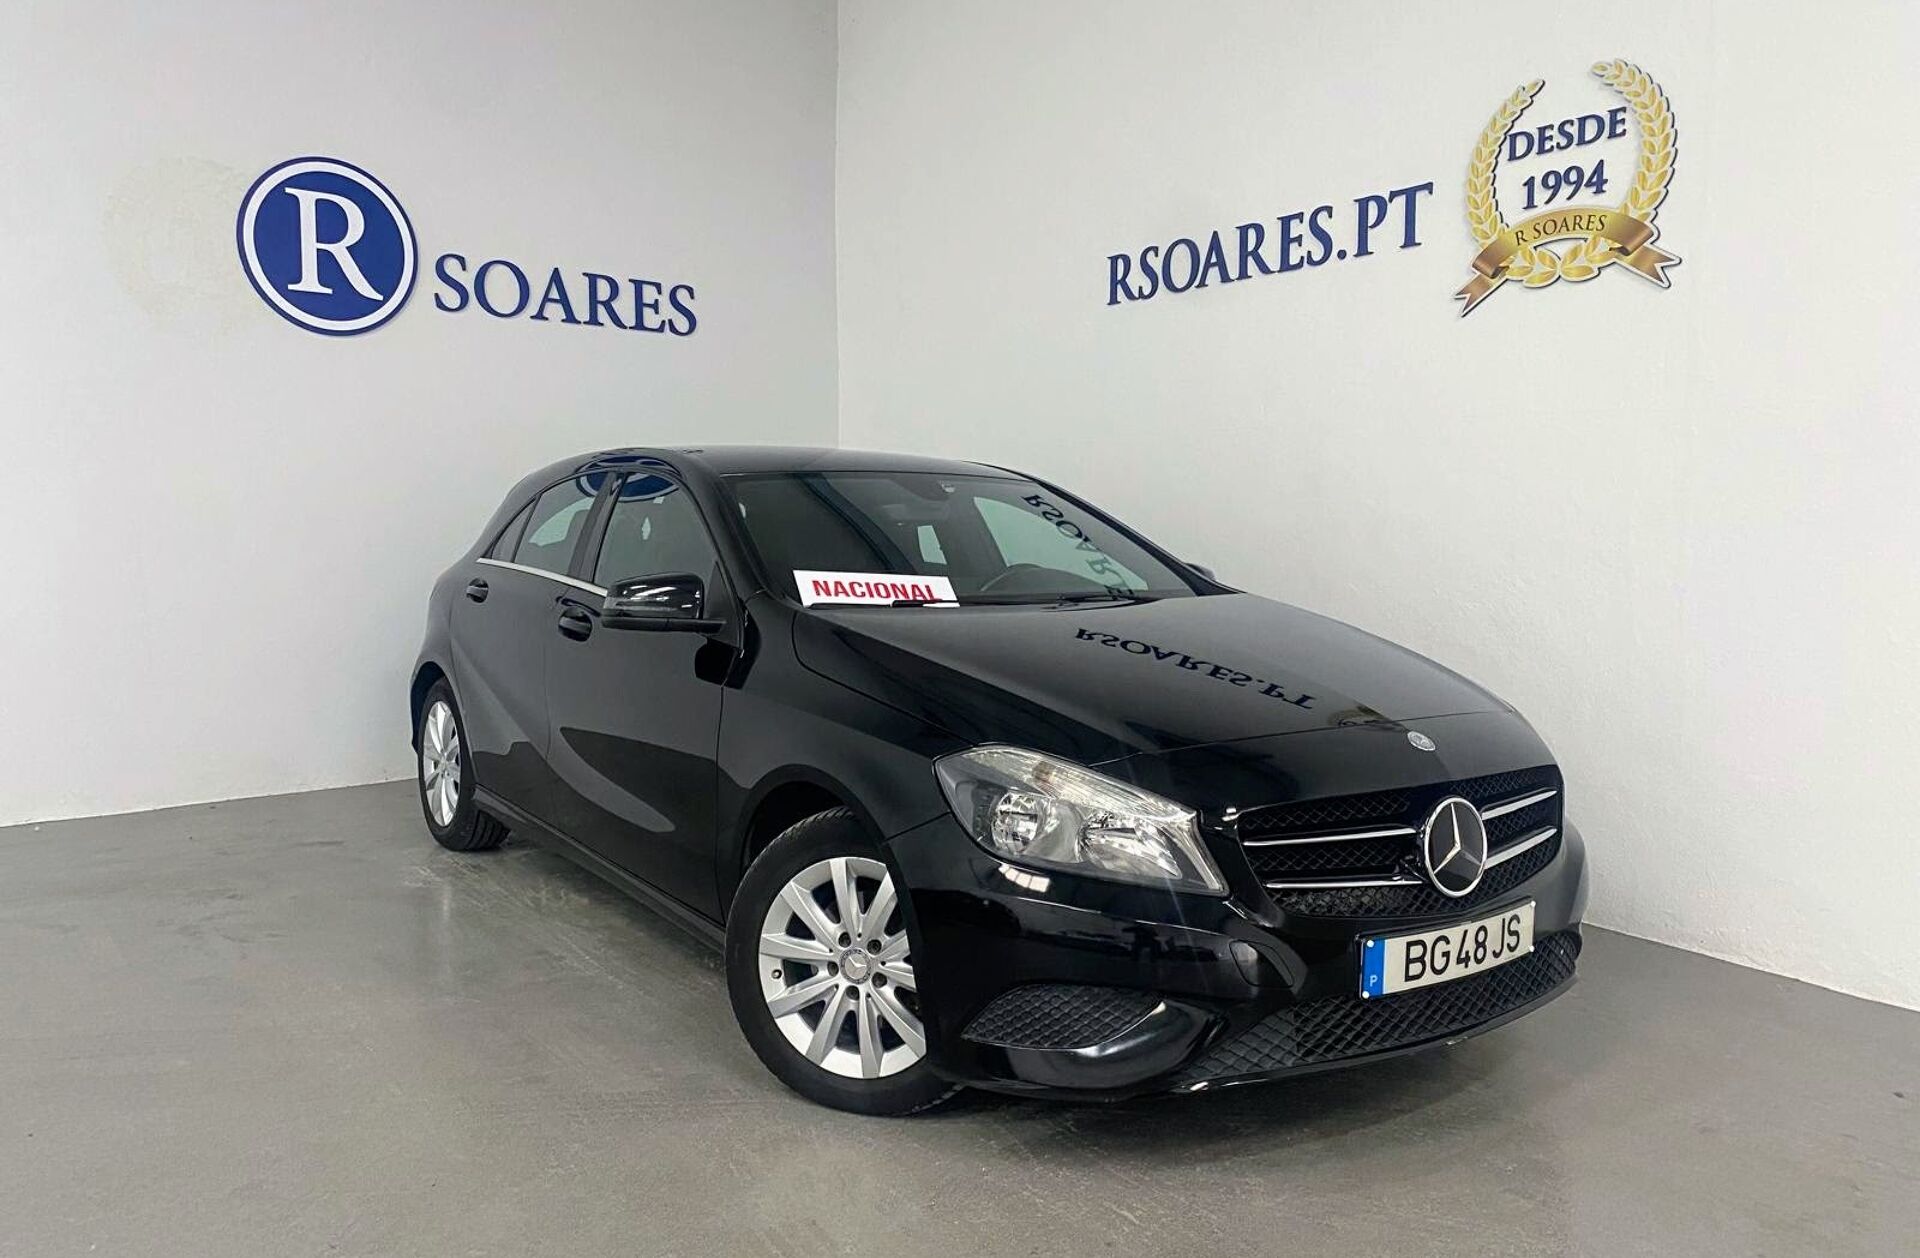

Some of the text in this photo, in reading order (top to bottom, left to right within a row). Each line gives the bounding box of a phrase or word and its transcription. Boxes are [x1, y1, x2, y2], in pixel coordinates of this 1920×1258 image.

[1507, 107, 1628, 162] DESDE
[1522, 159, 1608, 210] 1994
[1106, 182, 1433, 306] RSOARES.PT
[1515, 214, 1607, 246] R SOARES
[284, 186, 698, 337] R SOARES
[812, 580, 943, 602] NACIONAL
[1369, 974, 1378, 987] P
